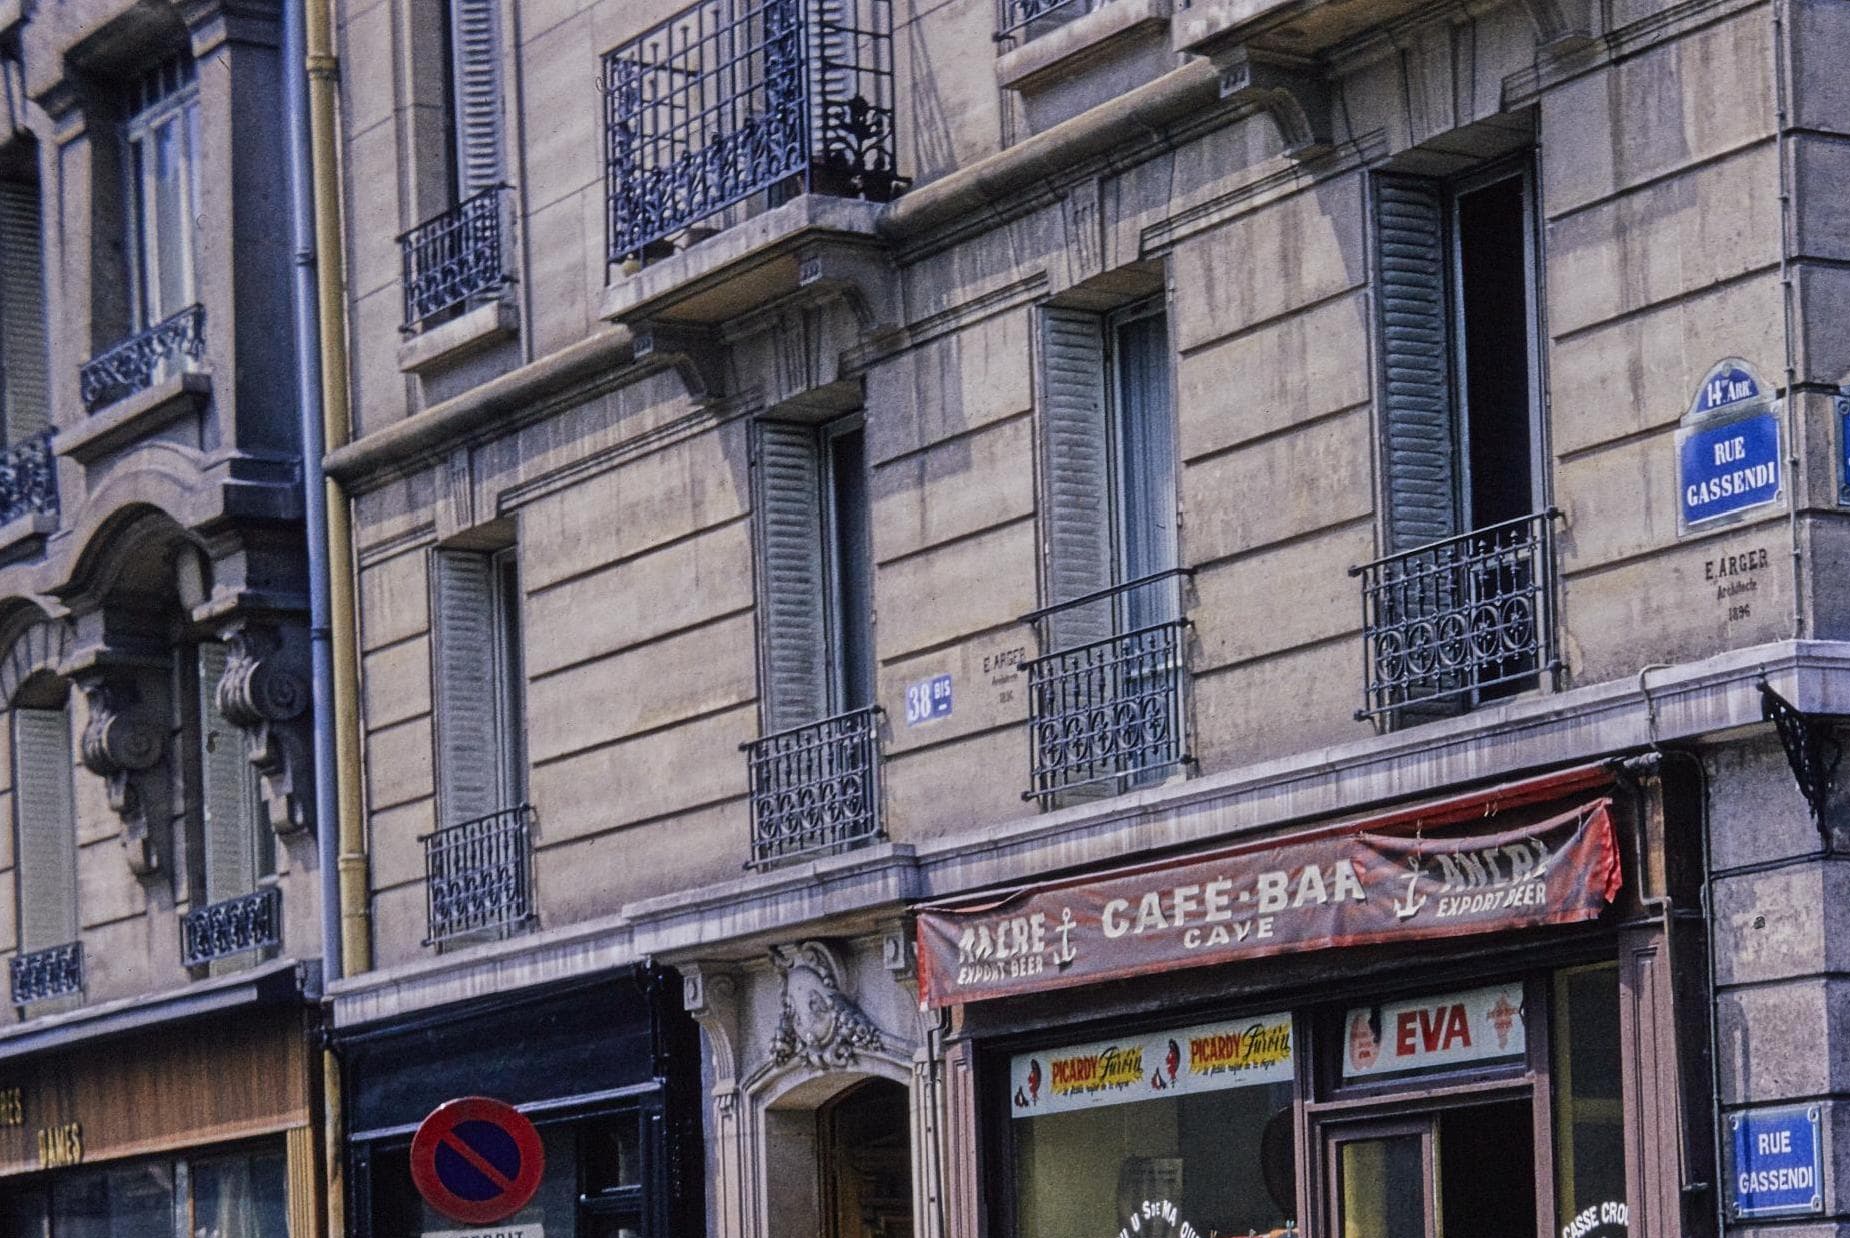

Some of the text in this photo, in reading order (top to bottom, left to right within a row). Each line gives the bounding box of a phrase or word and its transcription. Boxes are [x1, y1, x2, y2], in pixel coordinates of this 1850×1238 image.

[1714, 436, 1745, 466] RUE
[1686, 461, 1776, 507] GASSENDI
[907, 679, 951, 721] 38 BIS
[1437, 881, 1547, 918] EXPORT BEER
[1183, 915, 1275, 949] CAVE
[1011, 955, 1044, 978] BEER
[1396, 1002, 1472, 1058] EVA
[1190, 1033, 1242, 1064] PICARDY
[1052, 1056, 1099, 1084] PICARDY
[1758, 1131, 1792, 1155] RUE
[1740, 1166, 1813, 1195] GASSENDI
